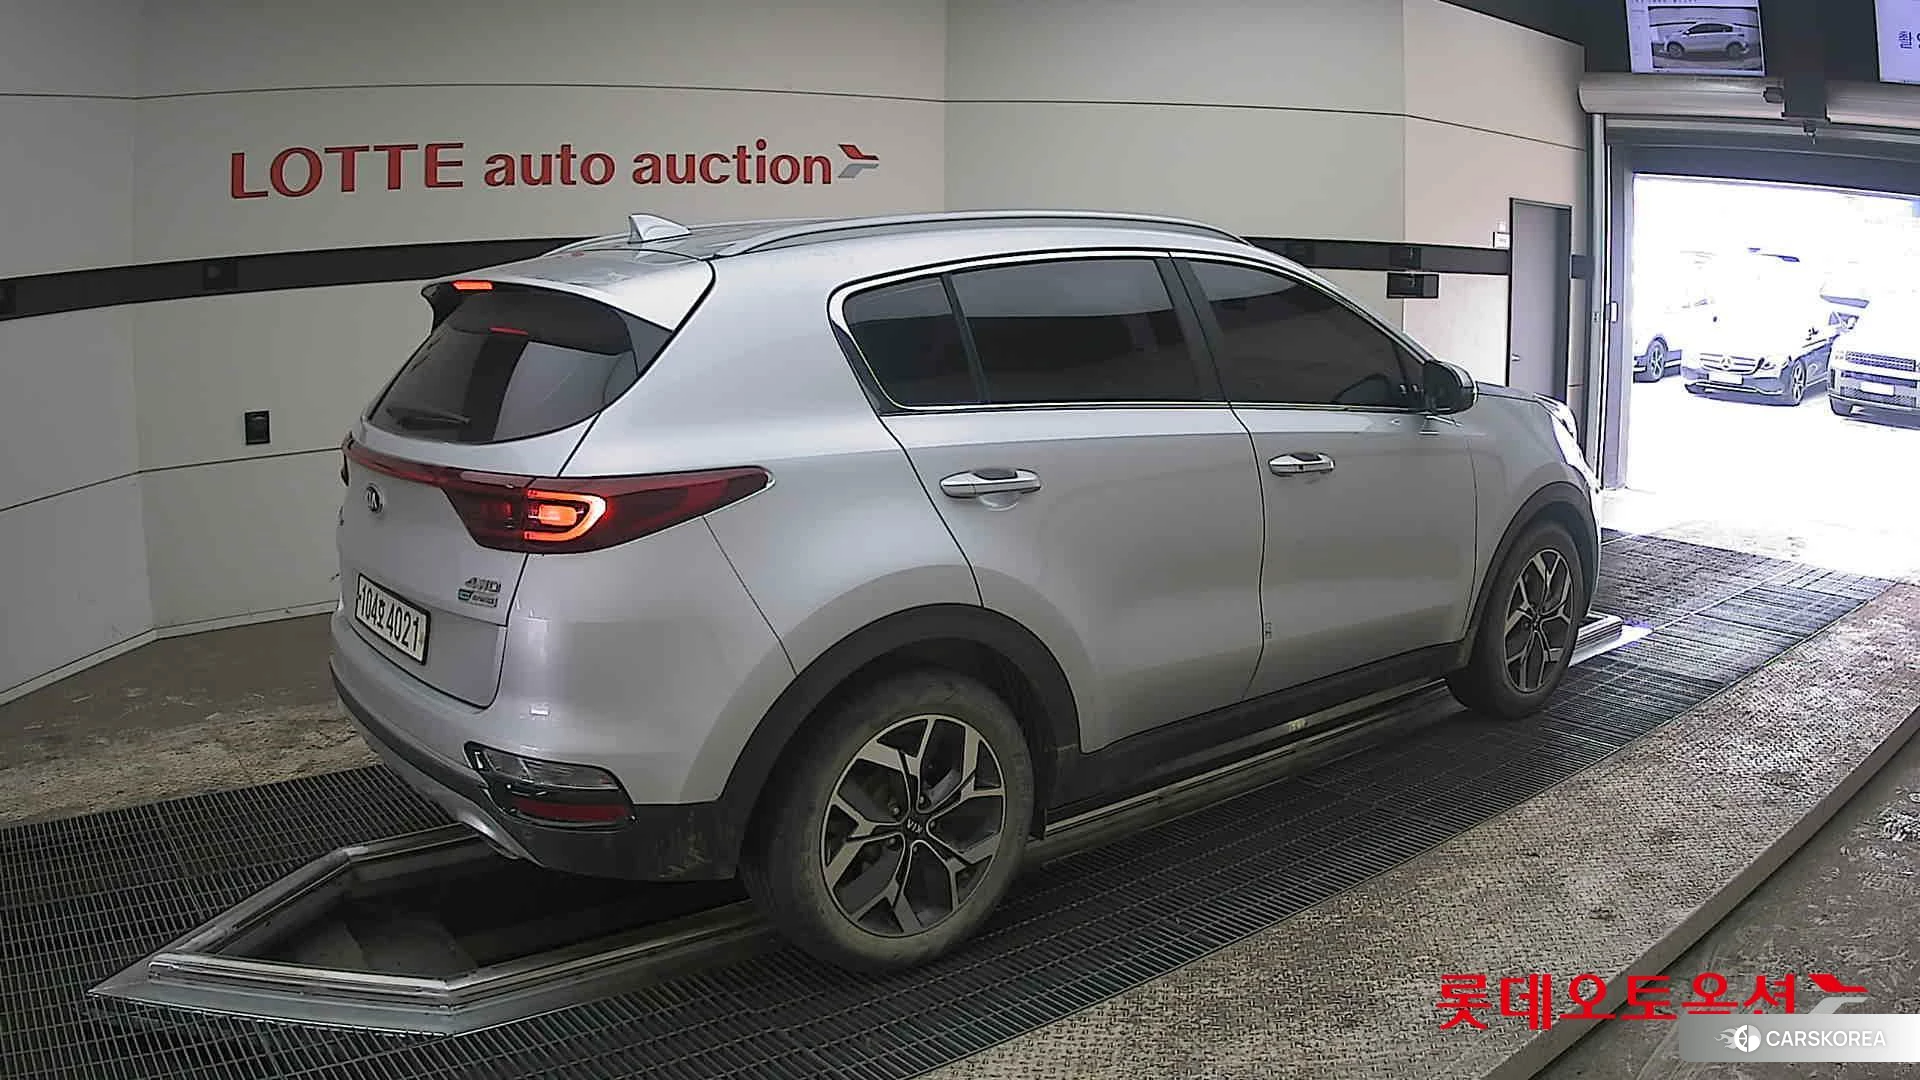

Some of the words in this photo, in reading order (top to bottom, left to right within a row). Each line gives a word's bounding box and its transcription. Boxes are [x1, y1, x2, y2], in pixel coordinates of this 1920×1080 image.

[231, 143, 464, 199] LOTTE
[484, 143, 616, 187] auto
[631, 138, 832, 185] auction
[386, 600, 420, 652] 4021
